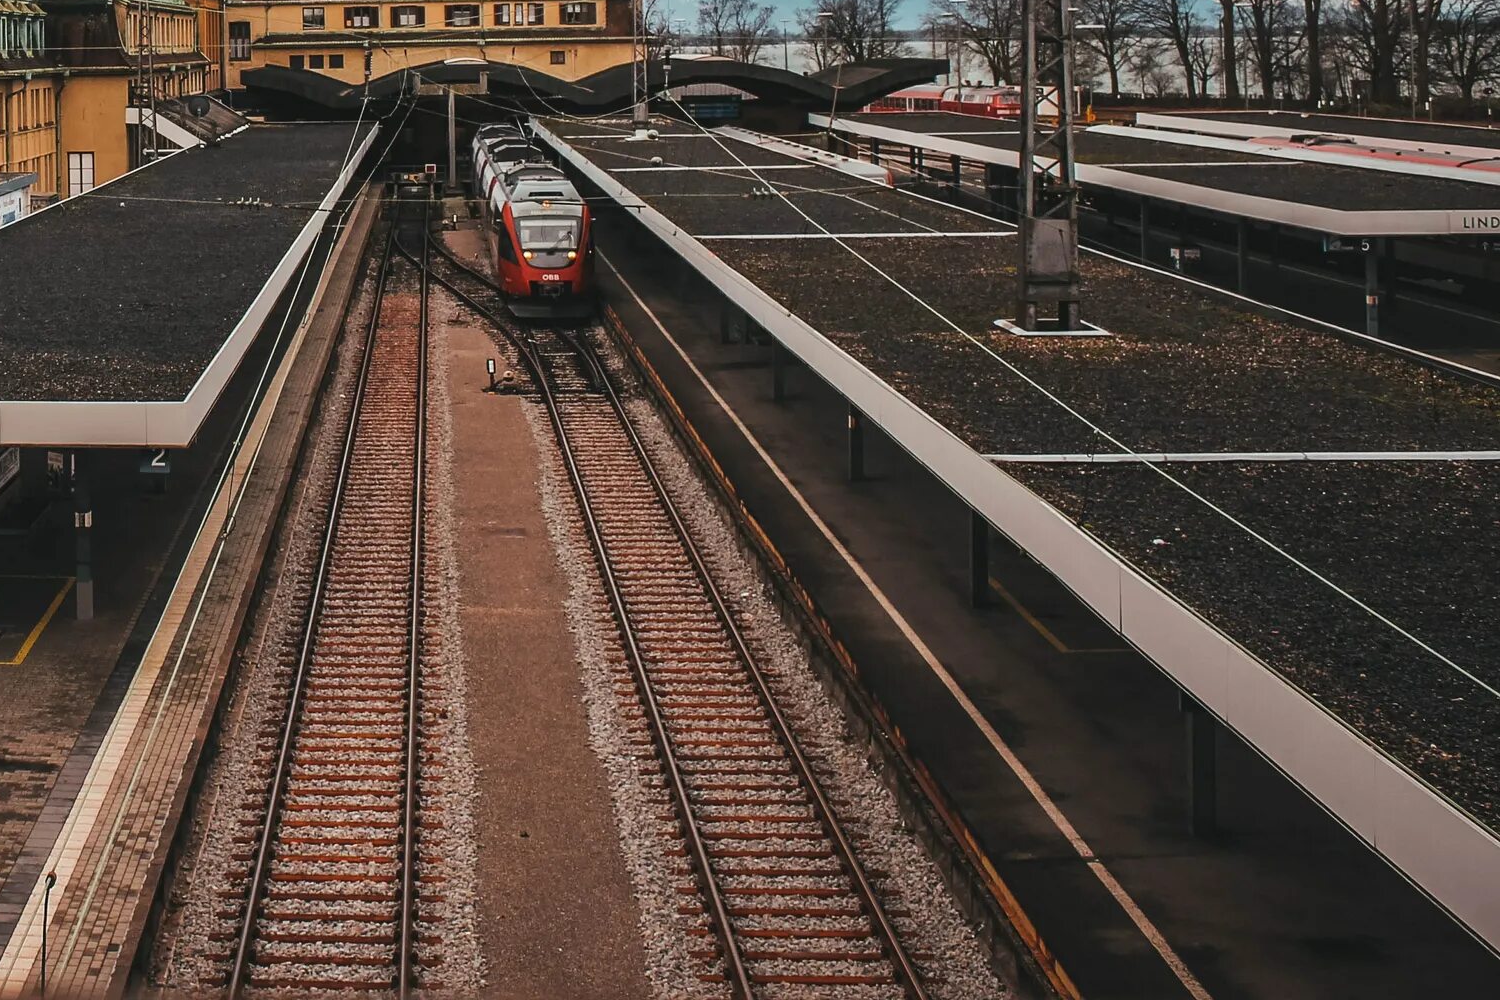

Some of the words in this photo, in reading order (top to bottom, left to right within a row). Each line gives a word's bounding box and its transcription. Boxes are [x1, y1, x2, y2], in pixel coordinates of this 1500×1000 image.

[1463, 216, 1500, 229] LIND
[1361, 239, 1370, 251] 5
[151, 449, 166, 467] 2
